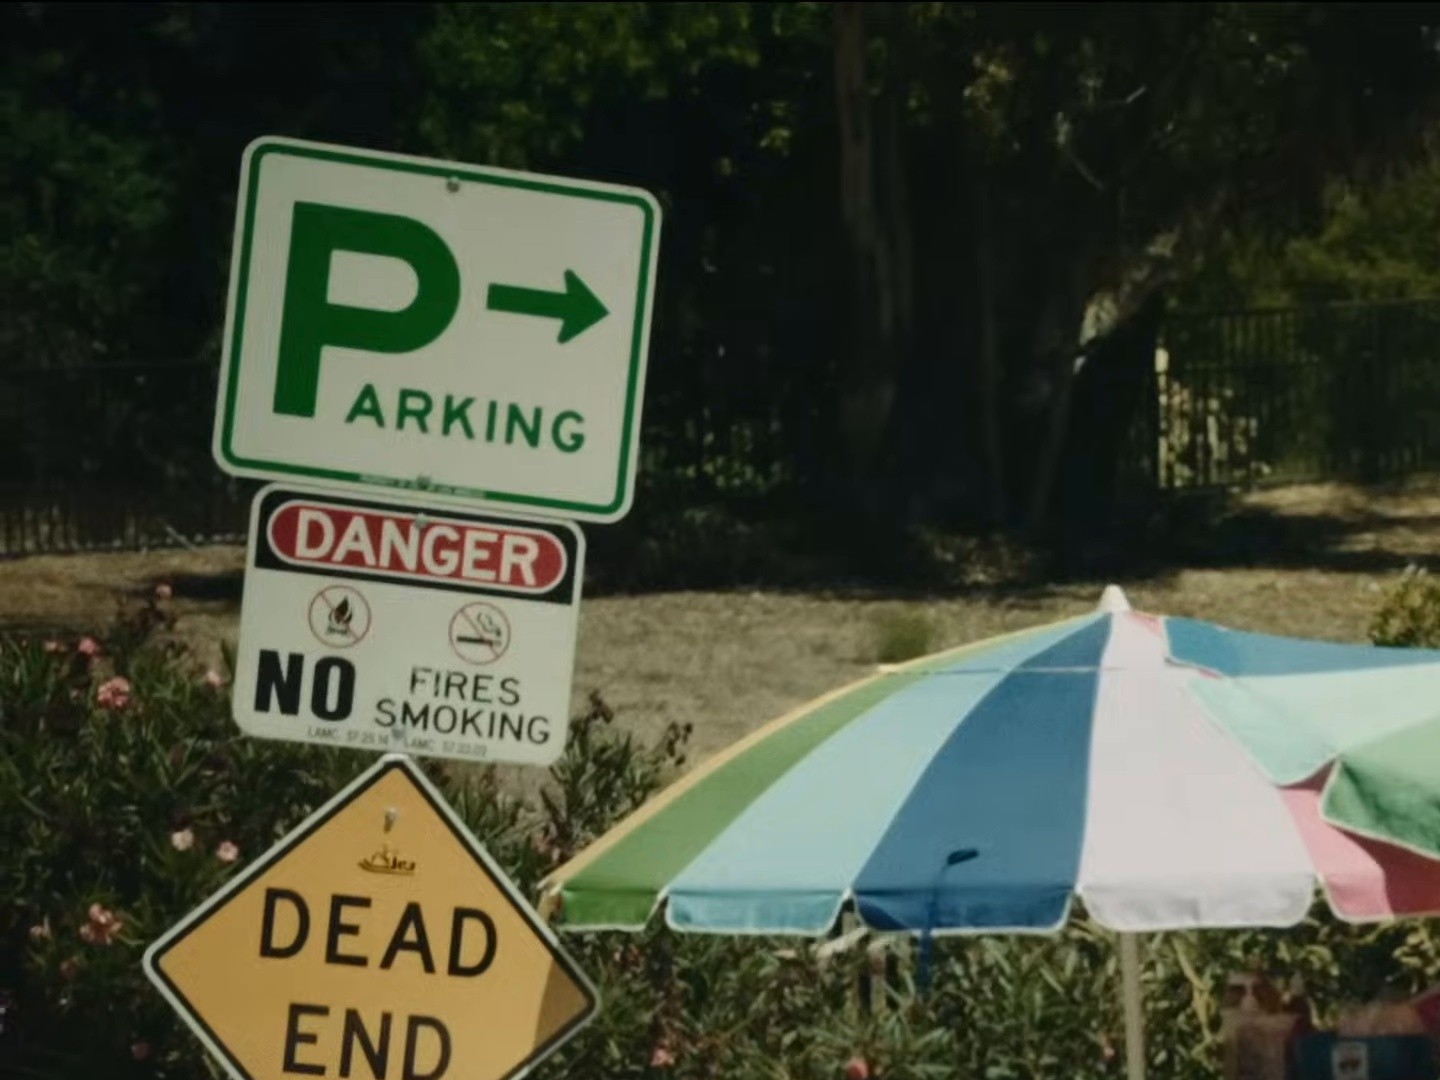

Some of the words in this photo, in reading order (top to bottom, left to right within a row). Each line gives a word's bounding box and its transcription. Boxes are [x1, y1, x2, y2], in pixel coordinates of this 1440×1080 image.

[294, 508, 541, 587] DANGER
[253, 648, 357, 722] NO
[373, 697, 551, 745] SMOKING
[409, 666, 521, 707] FIRES
[258, 886, 498, 978] DEAD
